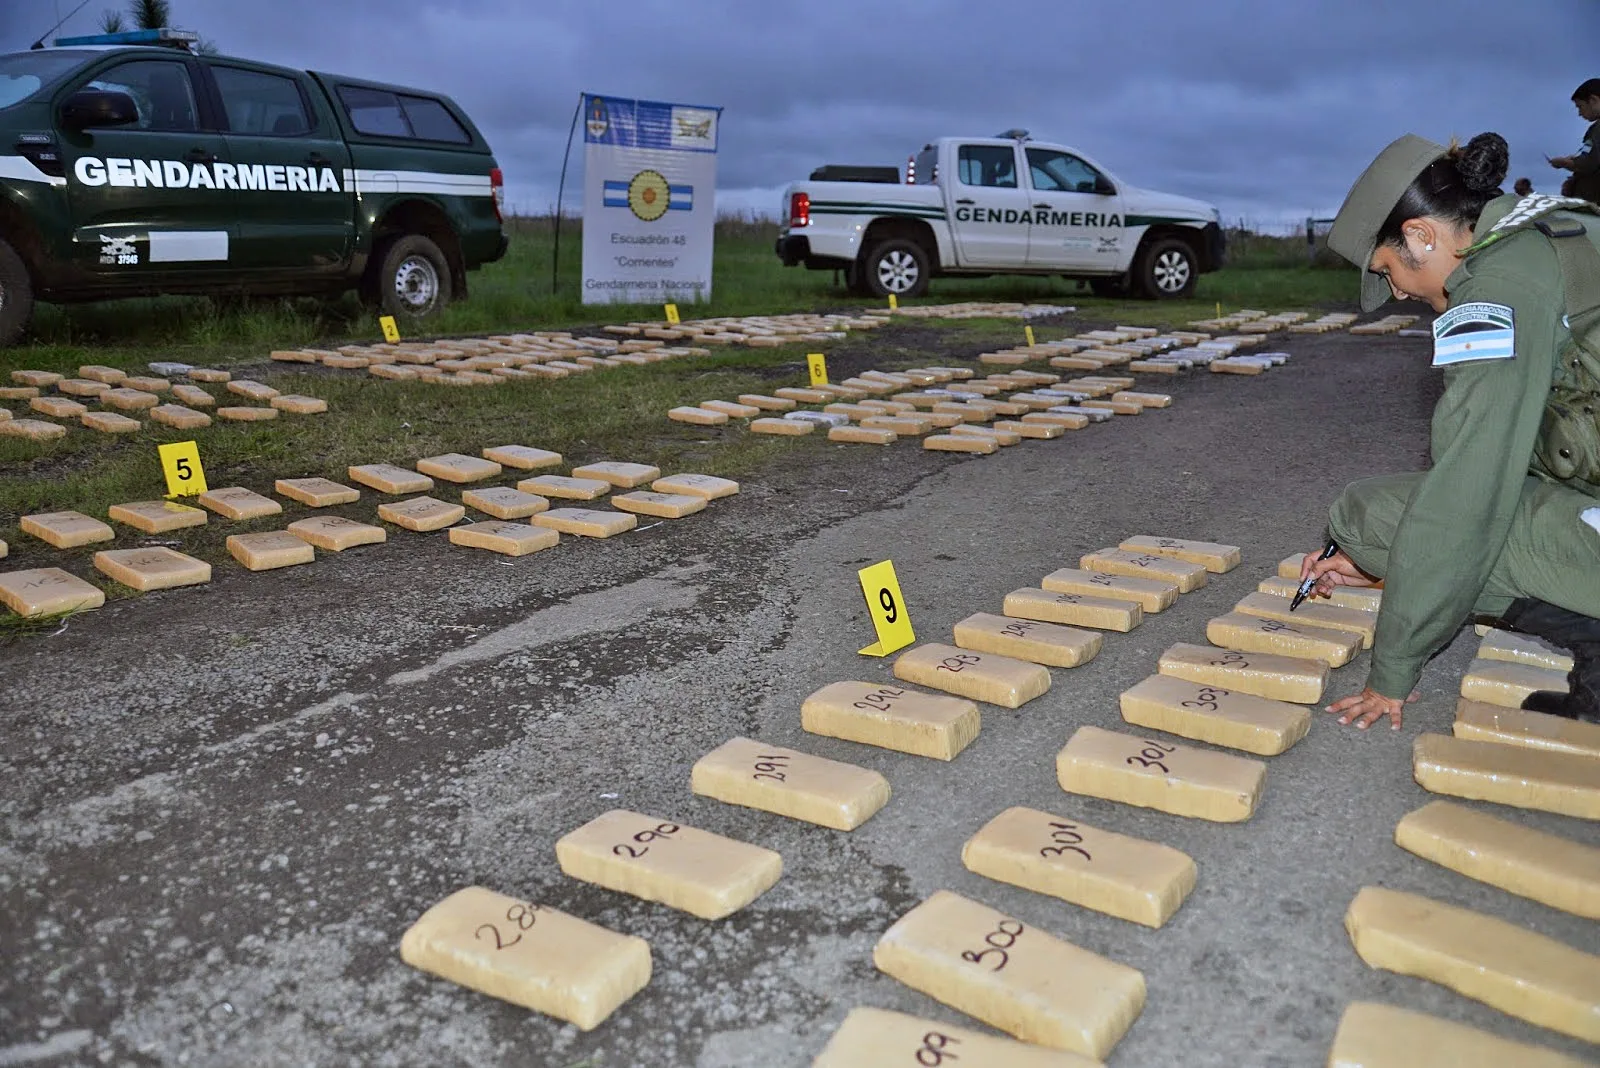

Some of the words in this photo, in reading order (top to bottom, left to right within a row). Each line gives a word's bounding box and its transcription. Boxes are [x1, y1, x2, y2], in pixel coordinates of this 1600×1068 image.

[74, 156, 341, 192] GENDARMERIA
[956, 207, 1121, 227] GENDARMERIA
[386, 325, 394, 336] 2
[815, 366, 823, 377] 6
[177, 458, 192, 480] 5
[879, 588, 897, 623] 9
[937, 654, 981, 672] 293
[853, 689, 904, 711] 292
[1181, 687, 1229, 711] 303
[753, 755, 790, 782] 291
[613, 823, 680, 858] 290
[1040, 822, 1091, 861] 301
[961, 919, 1023, 972] 300
